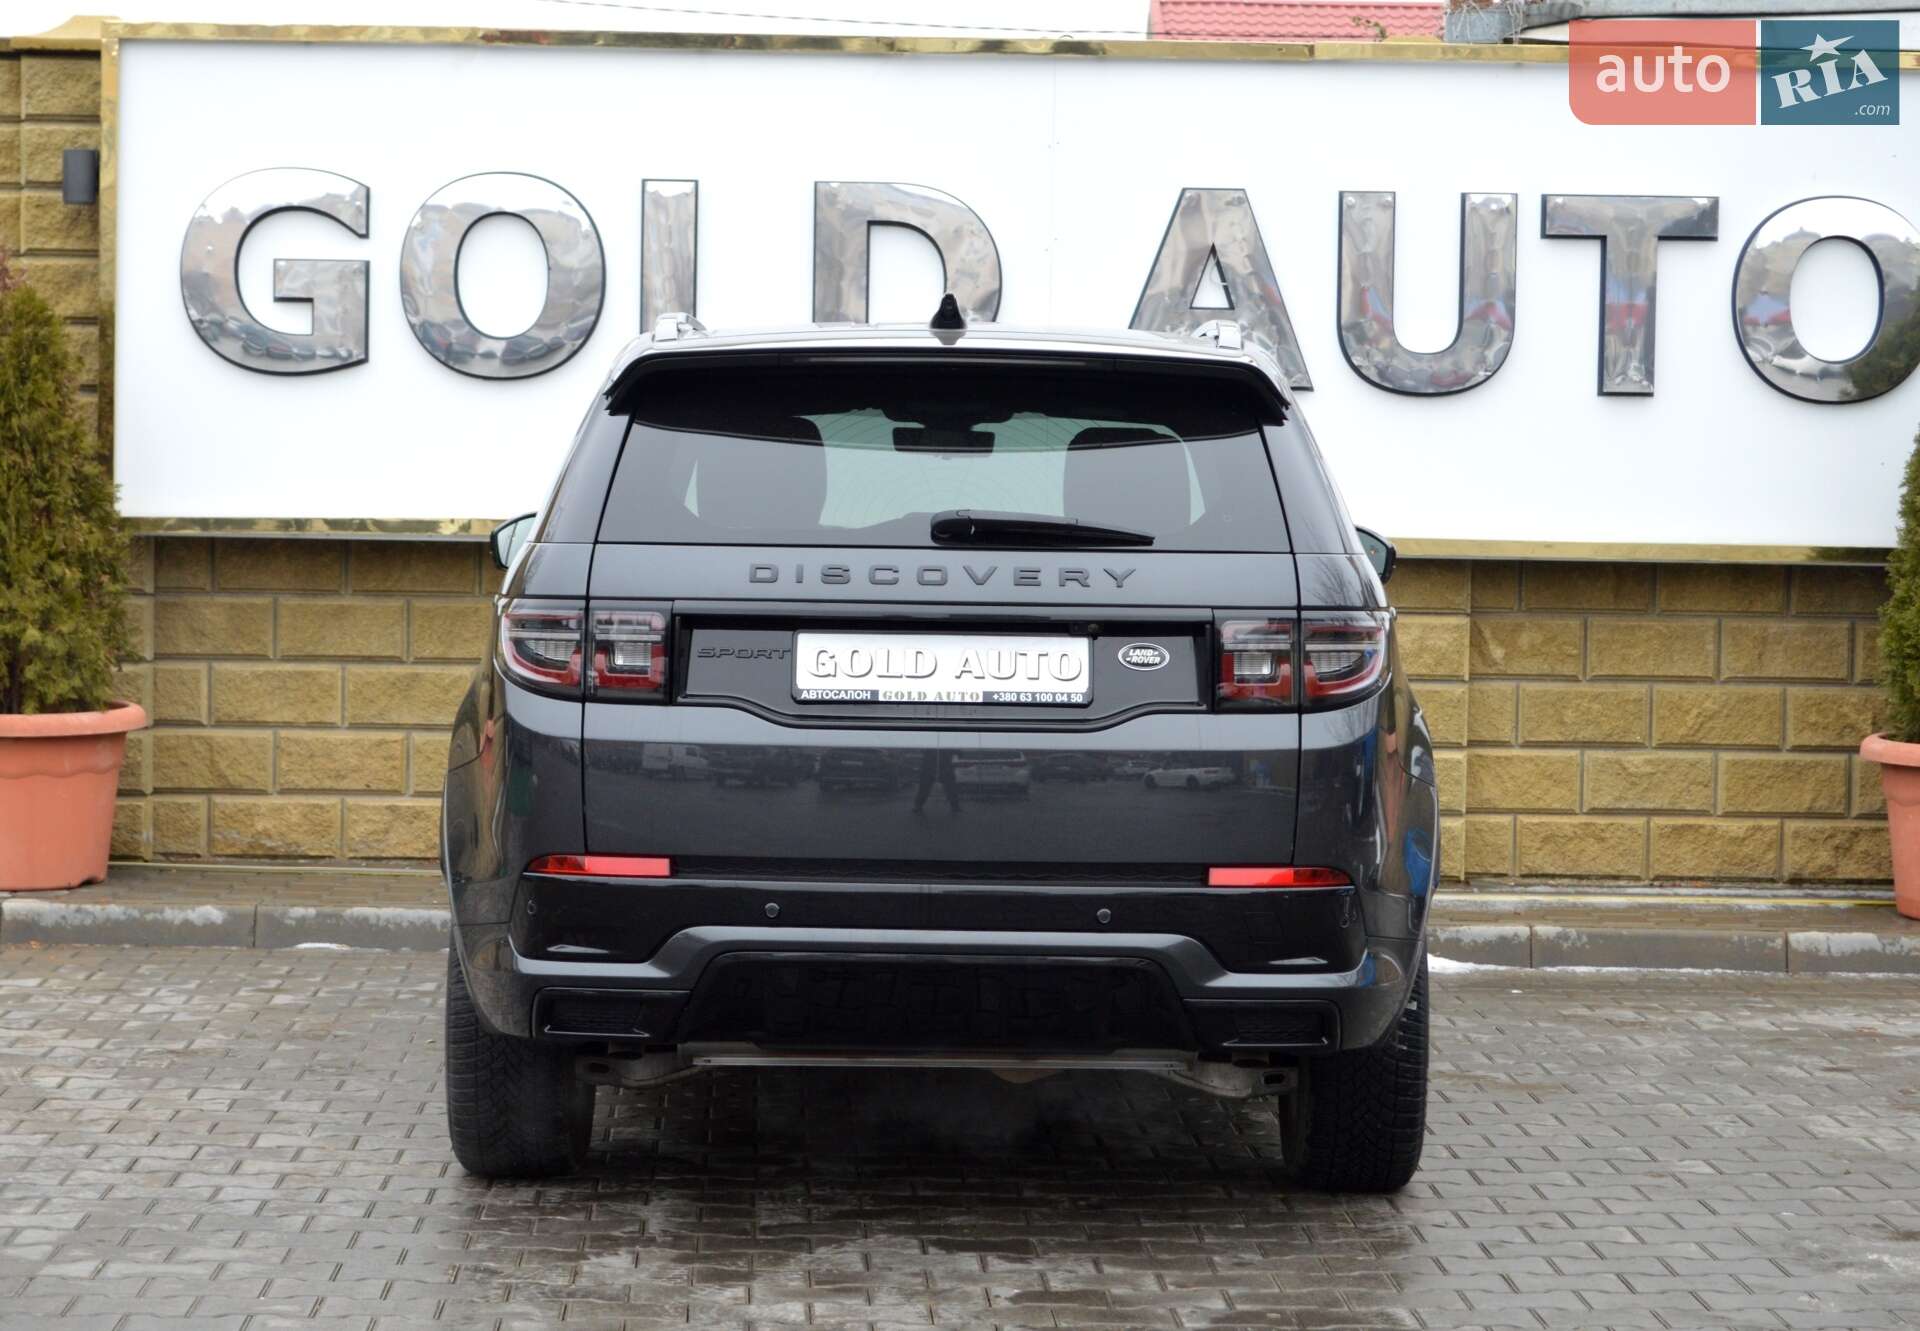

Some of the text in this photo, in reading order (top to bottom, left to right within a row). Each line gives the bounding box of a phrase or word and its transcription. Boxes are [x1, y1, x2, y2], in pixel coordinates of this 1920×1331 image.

[1128, 186, 1920, 404] AUTO
[748, 563, 1137, 589] DISCOVERY
[697, 648, 791, 660] SPORT
[804, 647, 1083, 682] GOLD AUTO
[800, 690, 871, 700] АВТОСАЛОН
[882, 690, 980, 702] GOLD AUTO
[992, 693, 1083, 703] +380 63 100 04 50
